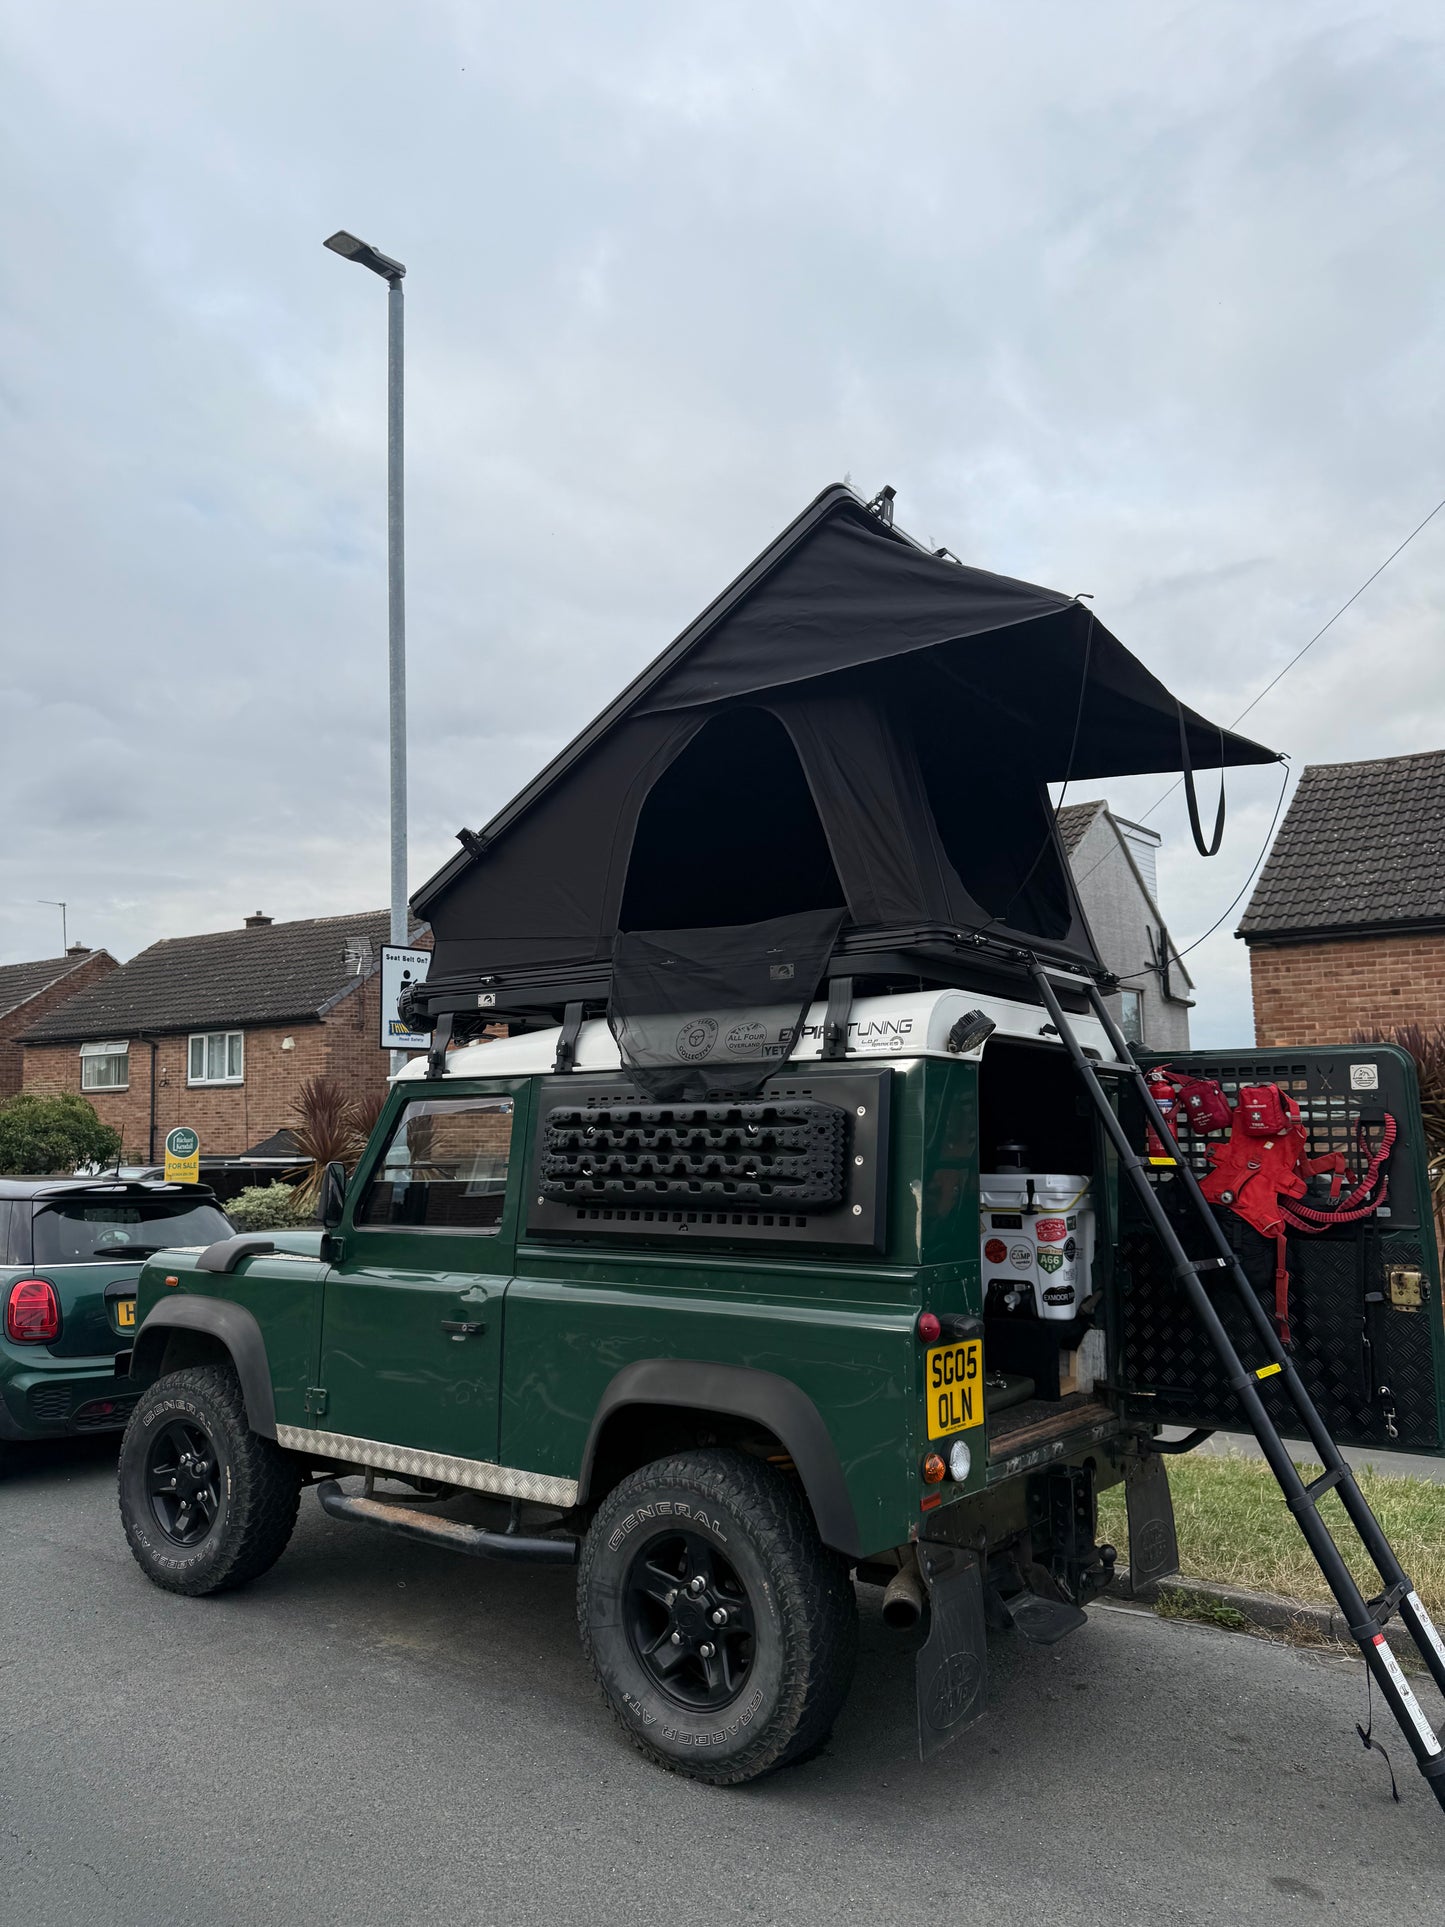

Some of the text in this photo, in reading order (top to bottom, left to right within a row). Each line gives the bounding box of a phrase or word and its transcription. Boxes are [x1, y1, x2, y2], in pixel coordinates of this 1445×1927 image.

[683, 1024, 693, 1034] ALL
[847, 1018, 913, 1037] TUNING
[679, 1044, 711, 1060] COLLECTIVE
[764, 1045, 788, 1055] YET
[1040, 1255, 1059, 1264] A66
[932, 1346, 977, 1388] SG05
[143, 1399, 214, 1436] GENERAL
[938, 1387, 972, 1428] OLN
[608, 1502, 727, 1552] GENERAL
[662, 1688, 764, 1747] GRABBER
